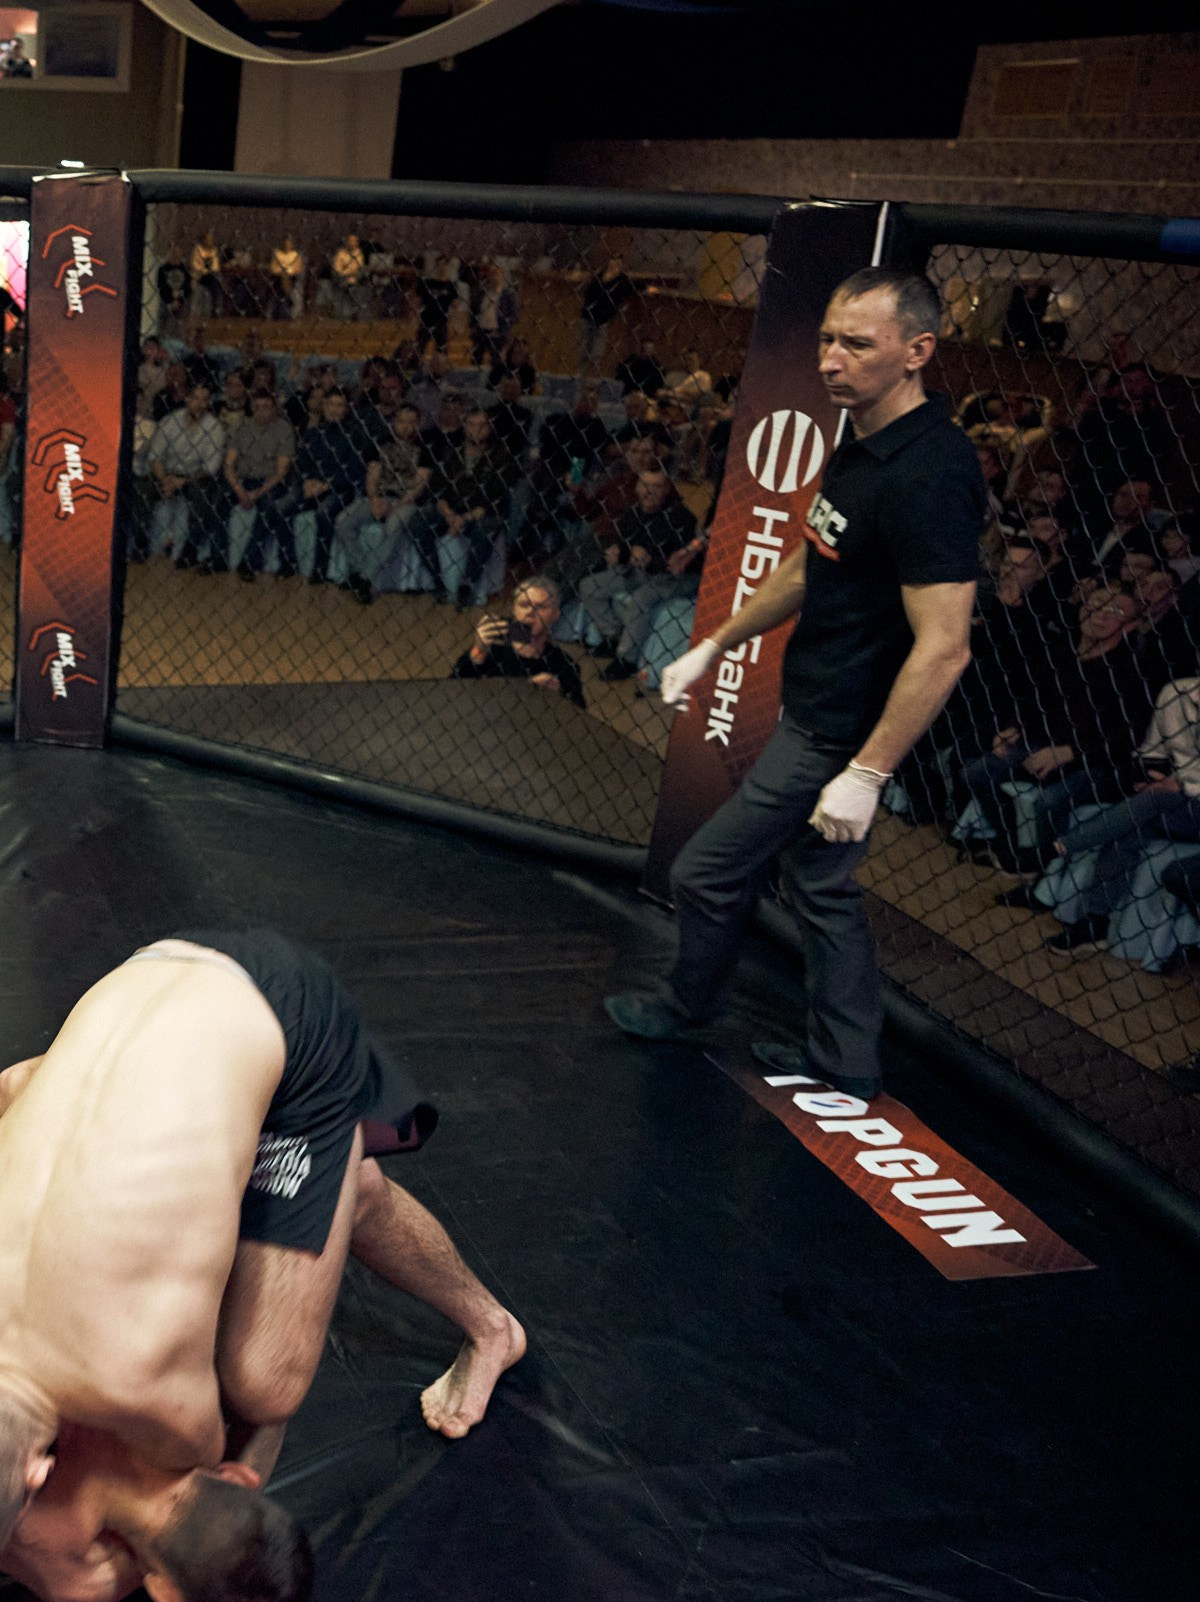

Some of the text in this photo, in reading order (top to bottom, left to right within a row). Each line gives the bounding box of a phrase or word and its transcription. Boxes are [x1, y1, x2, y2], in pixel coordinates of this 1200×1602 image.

[71, 235, 94, 277] MIX
[65, 269, 84, 314] FIGHT
[63, 443, 84, 482] MIX
[58, 473, 75, 514] FIGHT
[56, 632, 76, 668] MIX
